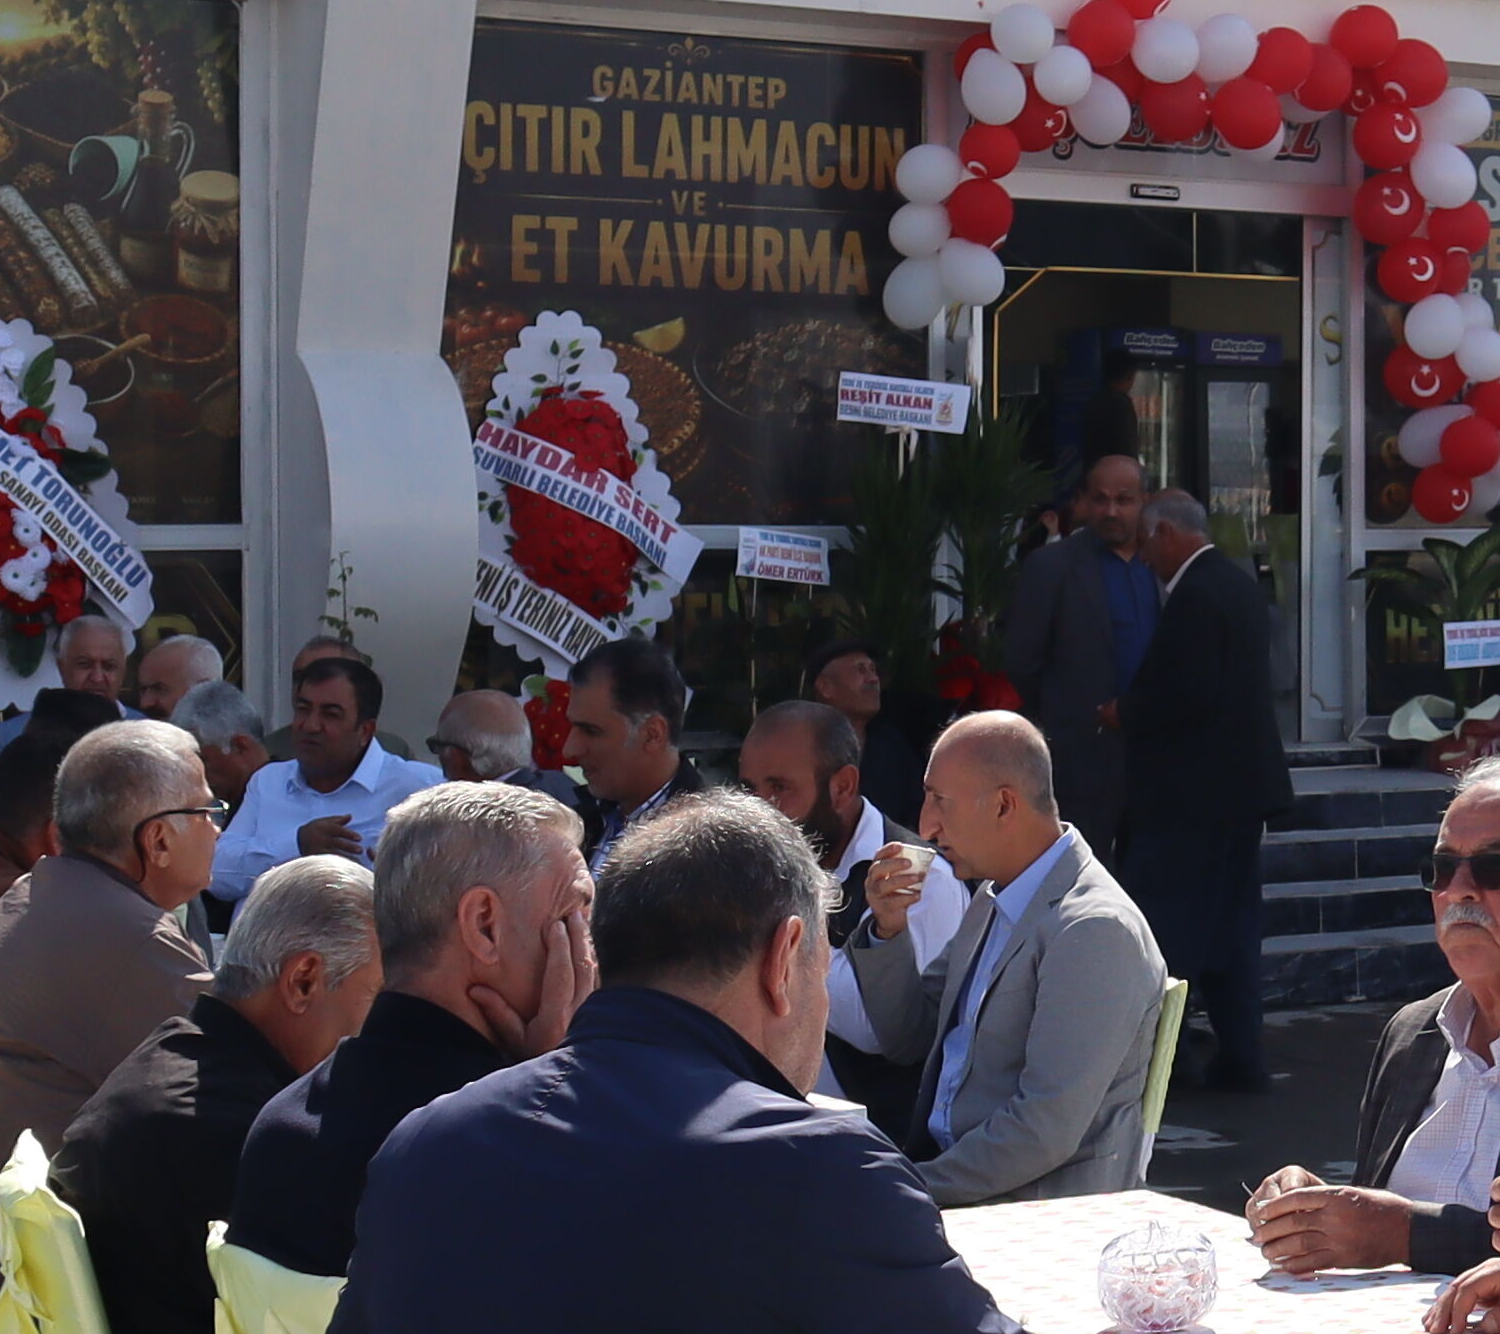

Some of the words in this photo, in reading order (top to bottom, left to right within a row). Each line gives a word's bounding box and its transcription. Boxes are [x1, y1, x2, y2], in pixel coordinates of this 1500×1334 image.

[592, 60, 787, 110] GAZİANTEP
[463, 101, 602, 184] ÇITIR
[621, 111, 905, 192] LAHMACUN
[672, 190, 707, 217] VE
[510, 214, 579, 285] ET
[600, 219, 869, 297] KAVURMA
[840, 388, 882, 405] REŞİT
[885, 394, 933, 410] ALKAN
[473, 445, 534, 488] SUVARLI
[536, 477, 612, 527] BELEDİYE
[613, 485, 678, 545] SERT
[32, 461, 149, 589] TORUNOĞLU
[41, 508, 80, 554] ODASI
[73, 536, 130, 603] BAŞKANI
[510, 578, 574, 644] YERİNİZ
